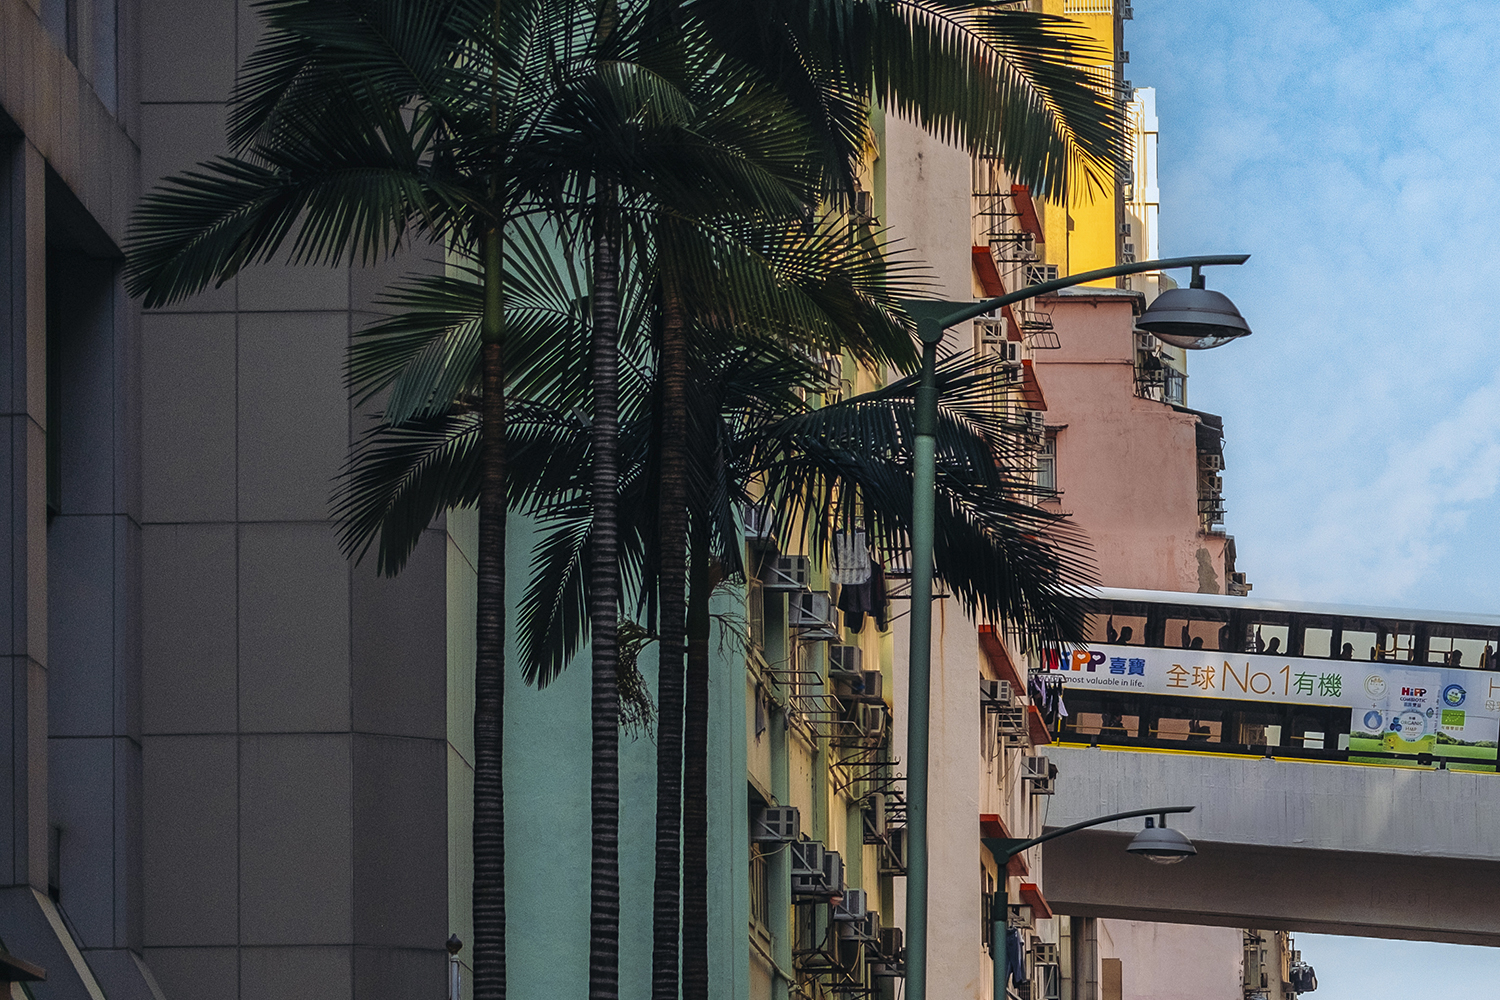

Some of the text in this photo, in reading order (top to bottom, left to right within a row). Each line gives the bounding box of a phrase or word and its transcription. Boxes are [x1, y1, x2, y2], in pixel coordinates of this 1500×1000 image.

[1109, 657, 1146, 676] 喜寶
[1086, 678, 1120, 686] valuable
[1166, 660, 1342, 698] 全球 No.1 有機
[1402, 687, 1427, 696] HiPP
